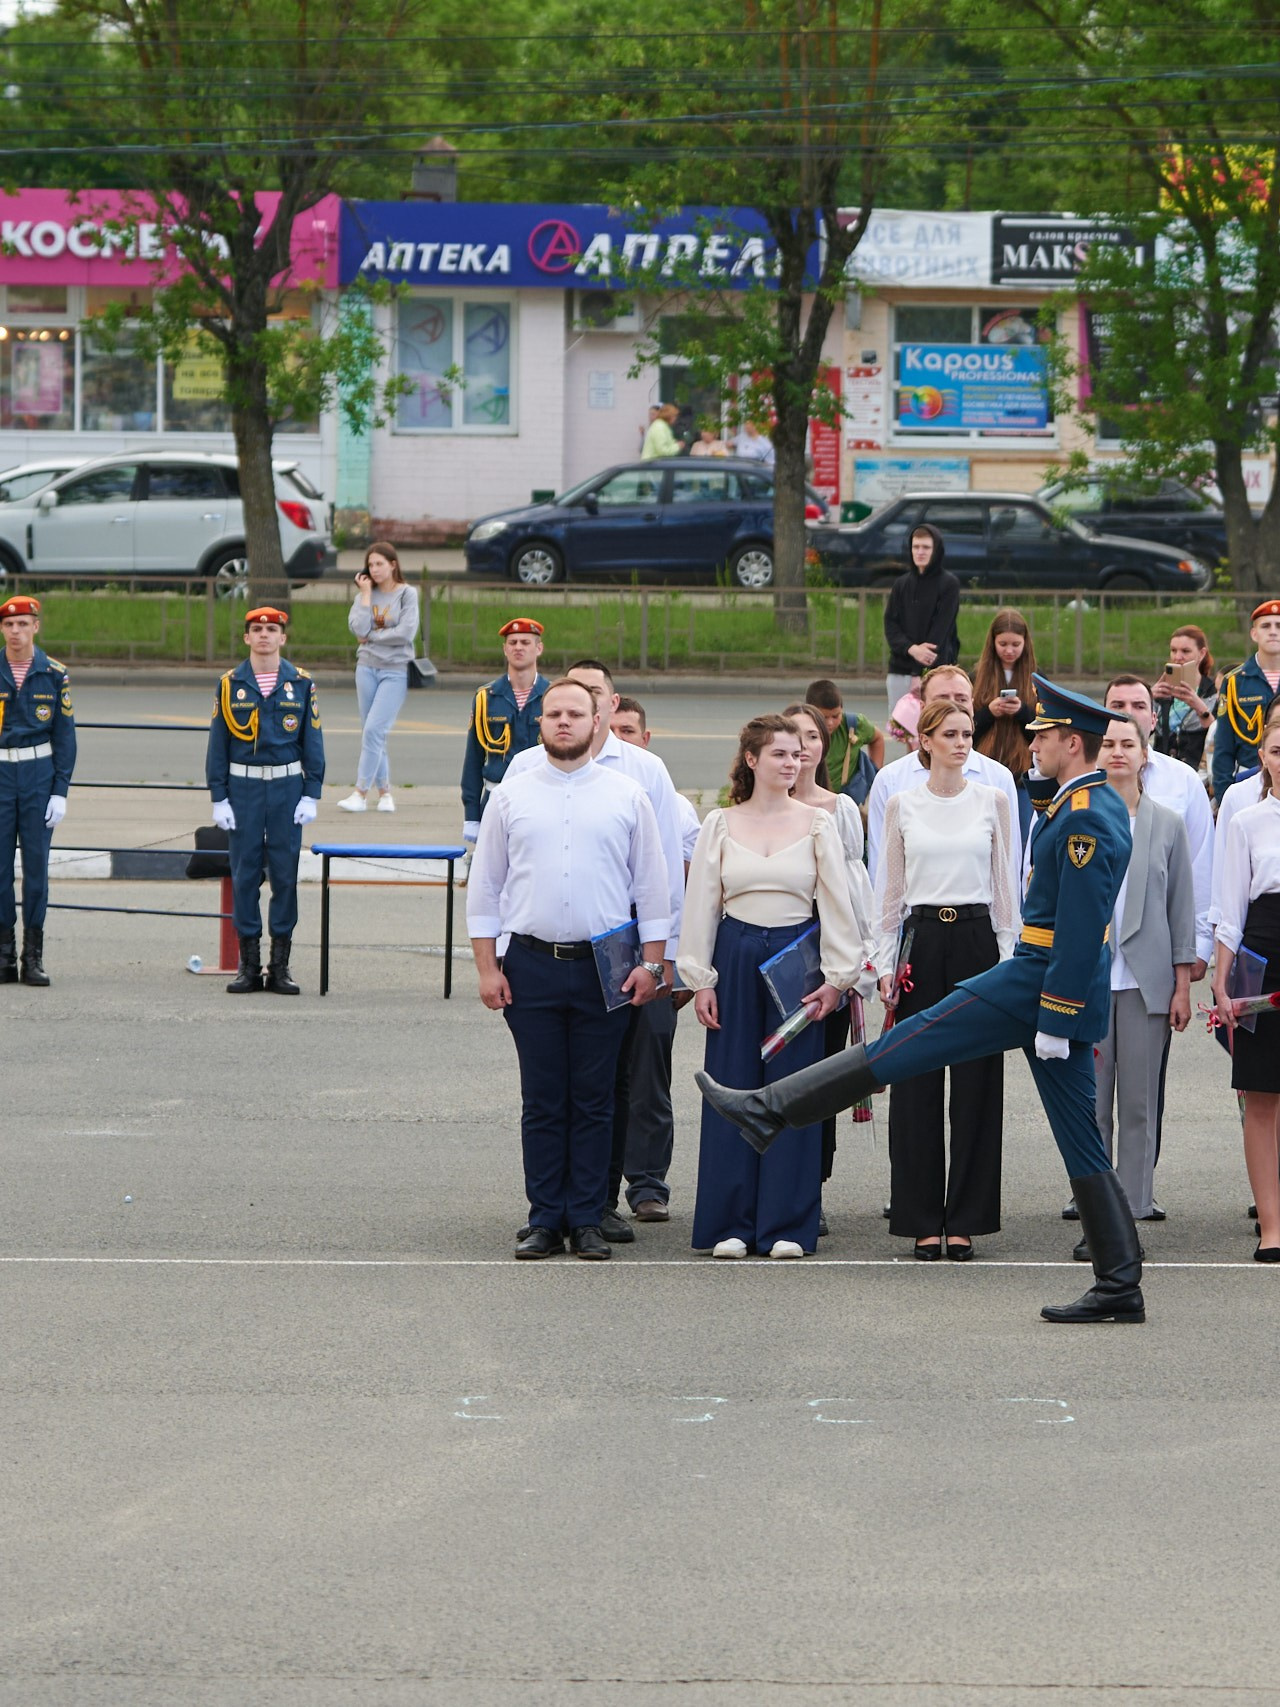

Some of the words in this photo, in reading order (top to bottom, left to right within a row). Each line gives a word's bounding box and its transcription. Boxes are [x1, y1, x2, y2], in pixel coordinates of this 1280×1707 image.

[914, 222, 961, 249] ДЛЯ
[359, 241, 513, 274] АПТЕКА
[905, 348, 1015, 375] Kapous
